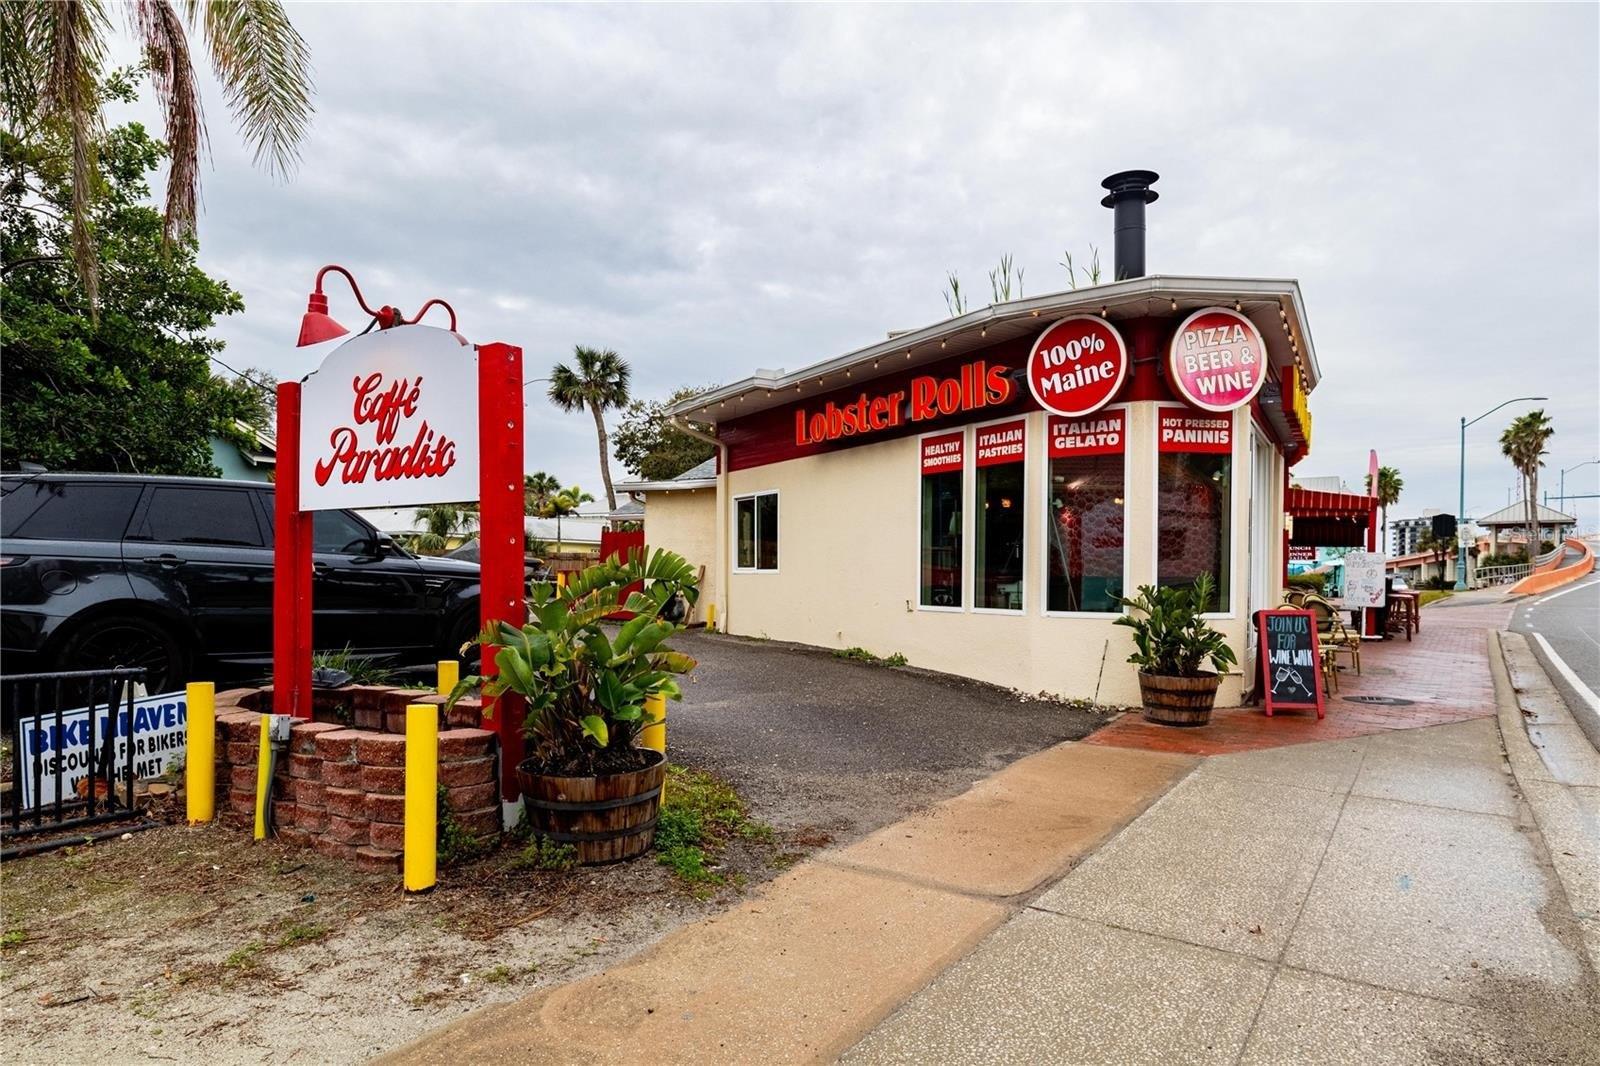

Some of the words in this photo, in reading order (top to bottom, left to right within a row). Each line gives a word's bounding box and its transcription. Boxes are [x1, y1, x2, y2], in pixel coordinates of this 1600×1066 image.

[1184, 324, 1247, 350] PIZZA
[1040, 333, 1105, 369] 100%
[1184, 350, 1234, 374] BEER
[1240, 347, 1255, 365] &
[1040, 360, 1115, 398] Maine
[1196, 371, 1253, 395] WINE
[353, 373, 423, 446] Caffé
[796, 391, 904, 446] Lobster
[911, 360, 1010, 421] Rolls
[1053, 419, 1121, 436] ITALIAN
[1163, 418, 1182, 427] HOT
[1185, 419, 1229, 429] PRESSED
[979, 429, 1023, 446] ITALIAN
[1055, 433, 1120, 449] GELATO
[1163, 429, 1229, 444] PANINIS
[315, 420, 456, 487] Paradiso
[925, 441, 960, 456] HEALTHY
[978, 443, 1023, 459] PASTRIES
[923, 454, 961, 467] SMOOTHIES
[1267, 616, 1293, 632] JOIN
[1295, 616, 1309, 635] US
[1277, 633, 1297, 650] FOR
[1268, 649, 1293, 665] WINE
[29, 720, 90, 756] BIKE
[113, 757, 162, 782] HEMET
